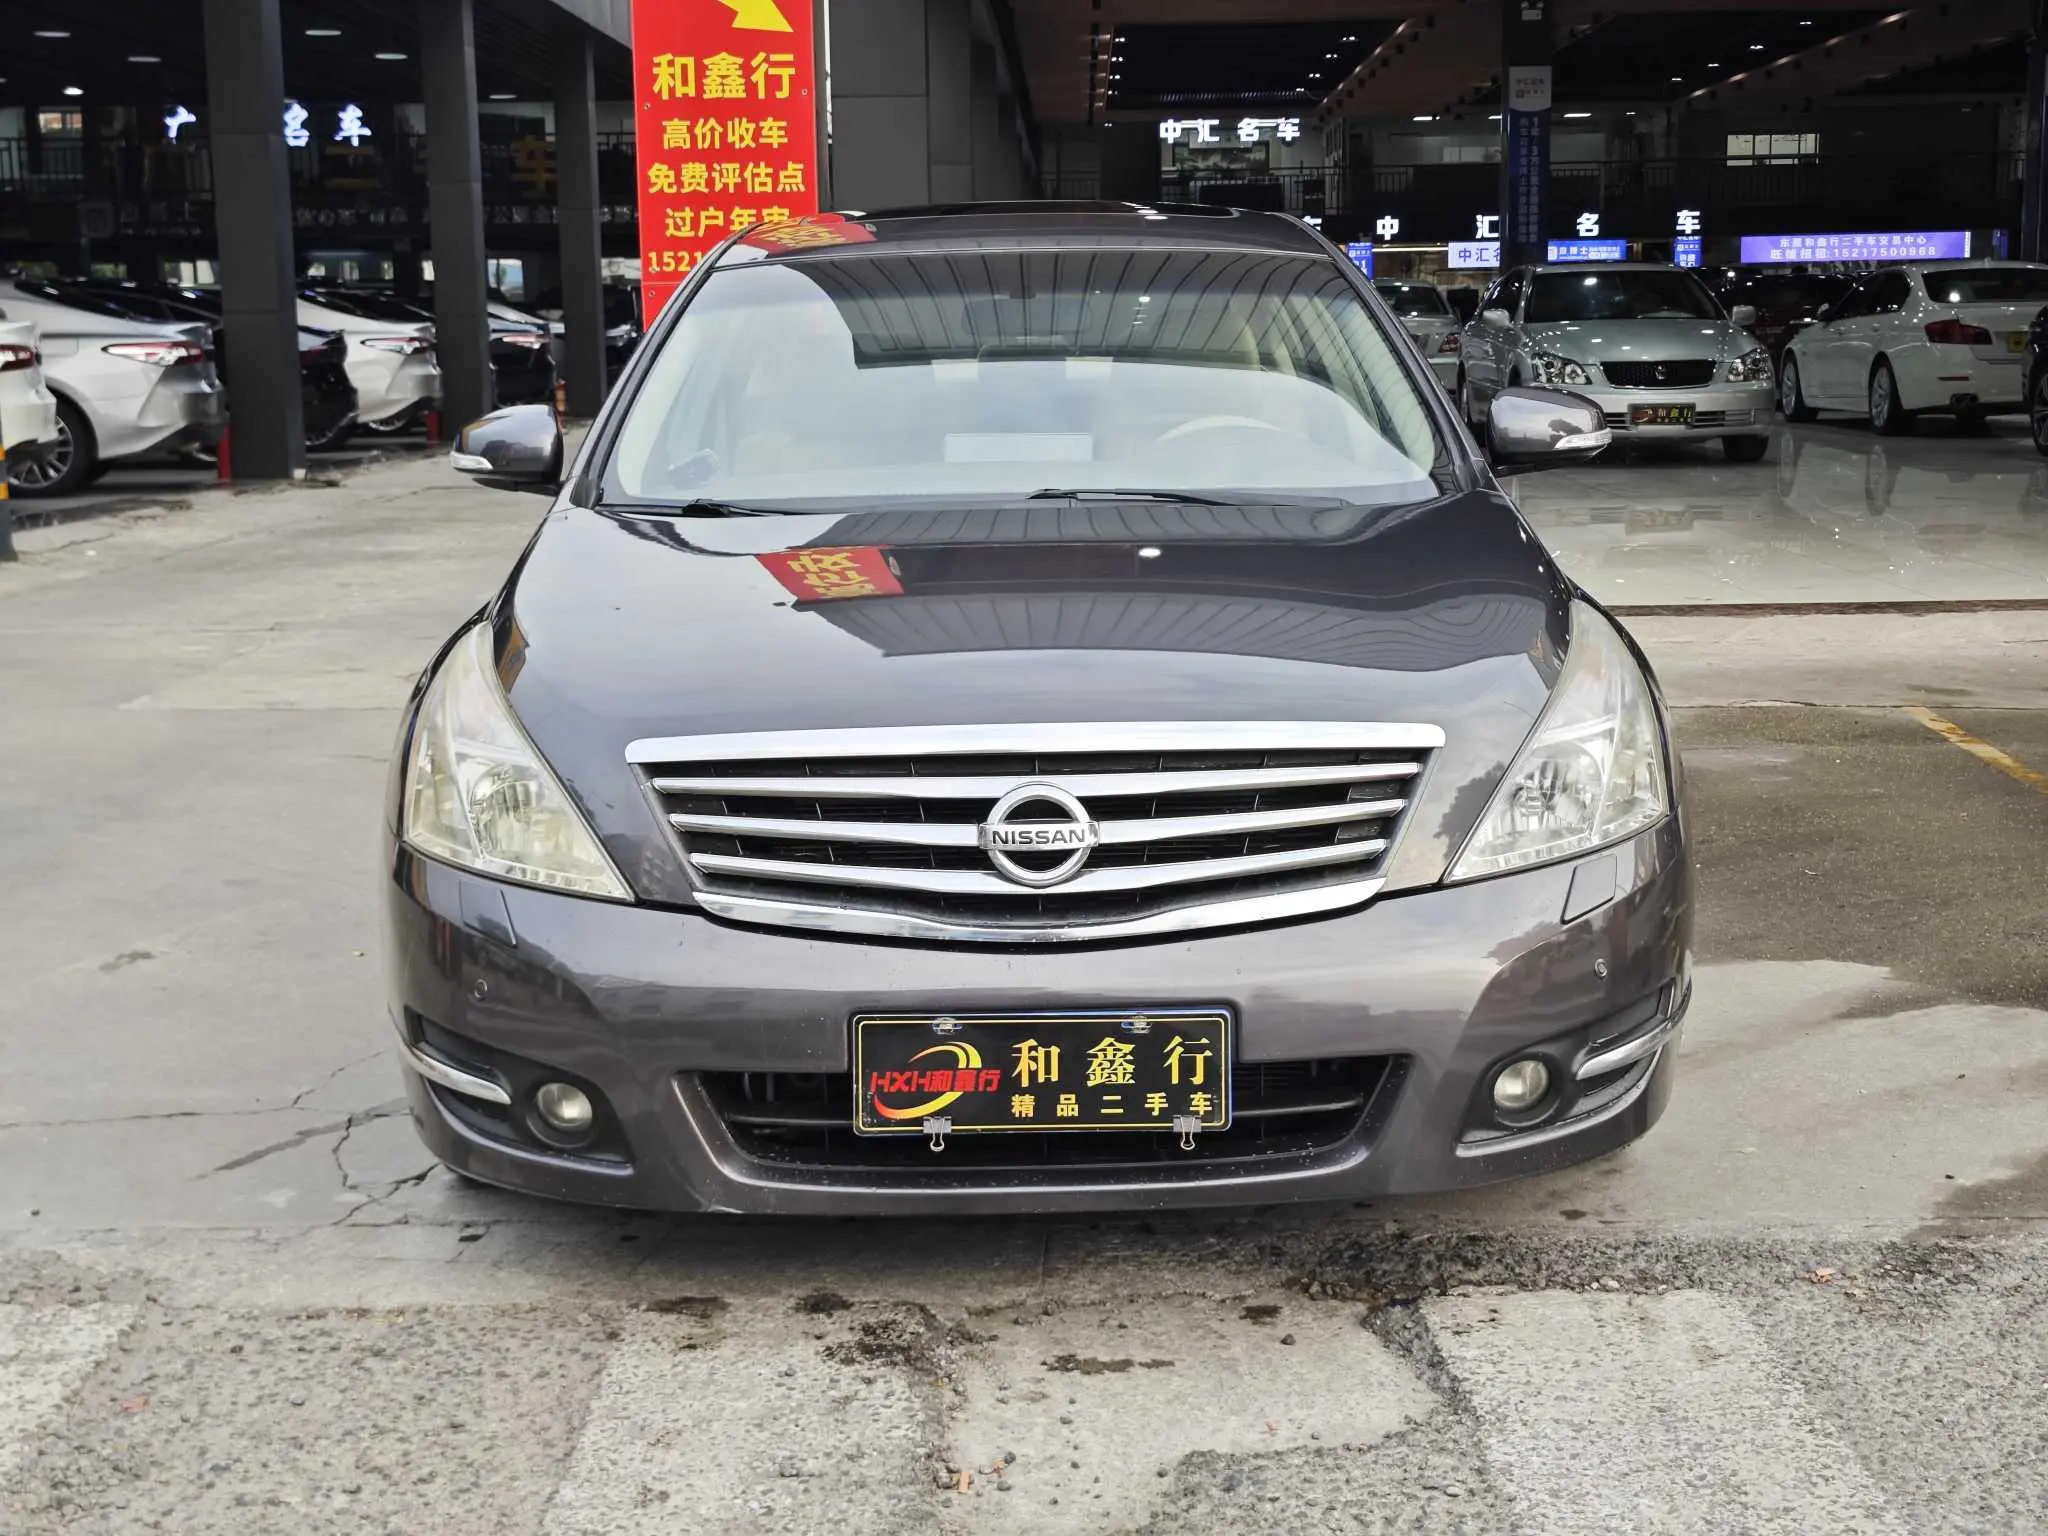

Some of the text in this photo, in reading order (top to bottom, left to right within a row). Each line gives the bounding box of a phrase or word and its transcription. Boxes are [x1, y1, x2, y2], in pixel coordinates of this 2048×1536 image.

[652, 51, 796, 100] 和鑫行
[662, 116, 789, 150] 高价收车
[1159, 117, 1301, 144] 中汇名车
[647, 161, 806, 194] 免费评估点
[992, 829, 1086, 845] NISSAN
[1011, 1035, 1214, 1088] 和鑫行
[1011, 1091, 1213, 1118] 精品二手车
